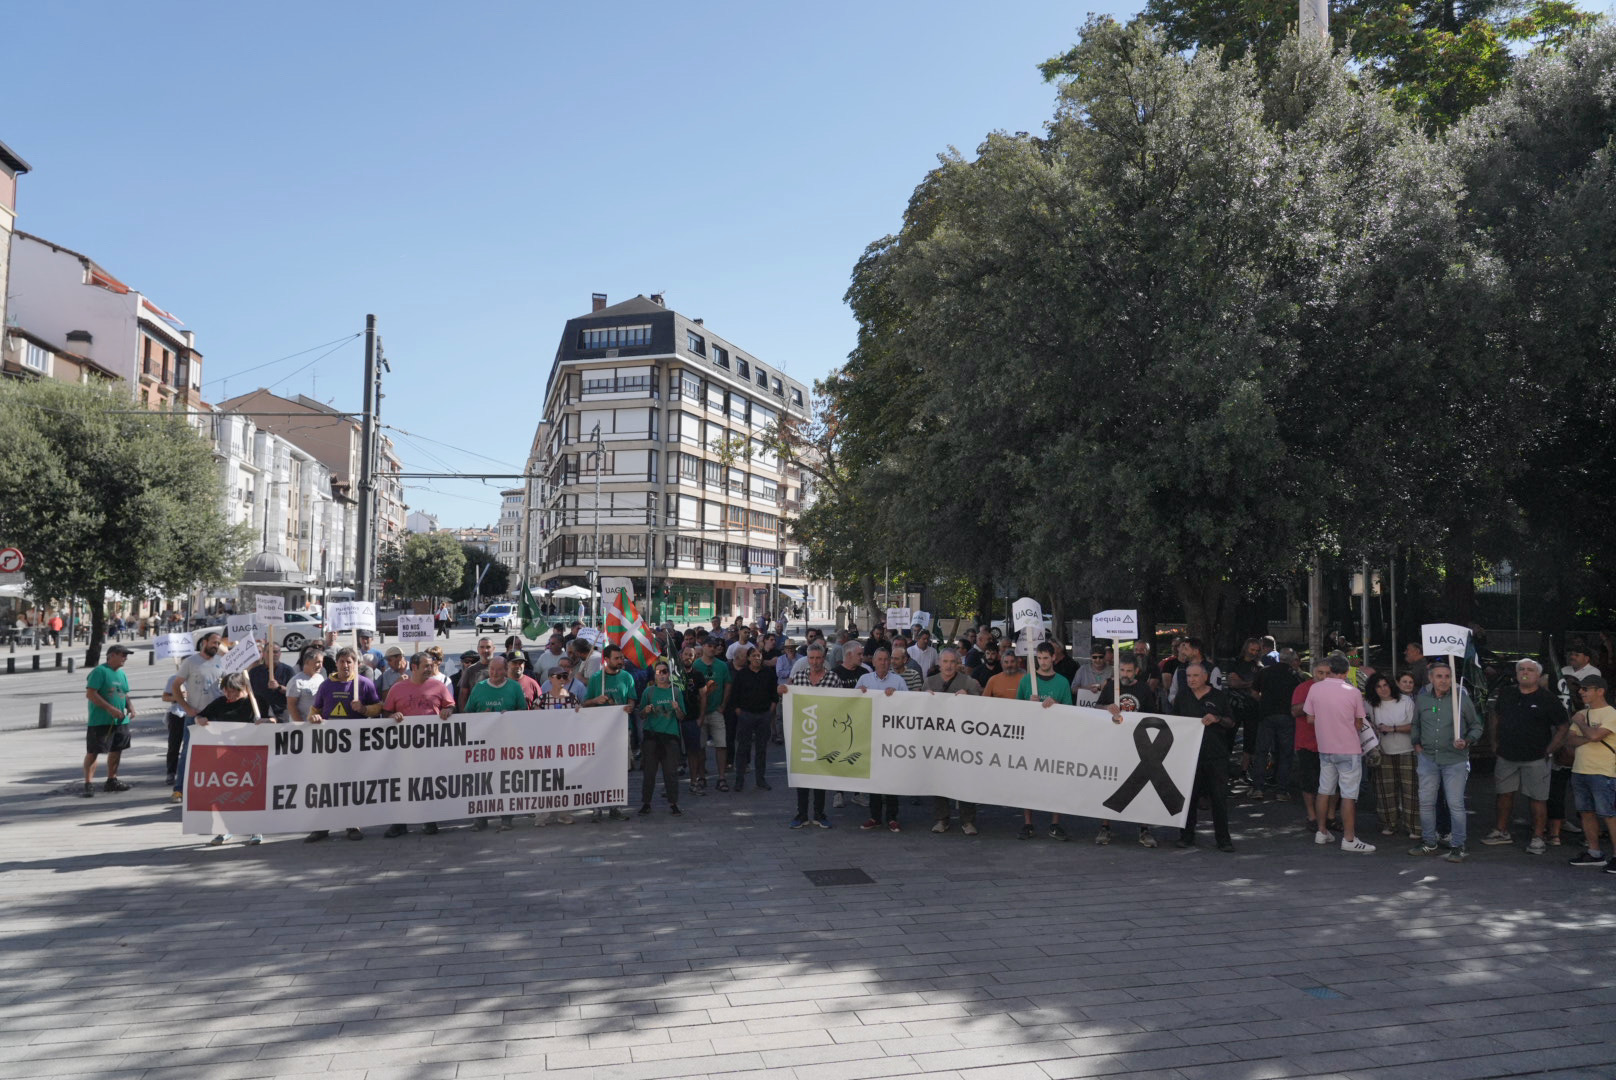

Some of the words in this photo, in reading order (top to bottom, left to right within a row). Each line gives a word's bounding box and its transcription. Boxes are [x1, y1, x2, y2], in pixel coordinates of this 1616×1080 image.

[1016, 608, 1038, 620] UAGA
[232, 624, 258, 632] UAGA
[1430, 635, 1464, 646] UAGA
[274, 730, 304, 756] NO
[312, 728, 352, 754] NOS
[360, 722, 486, 751] ESCUCHAN...
[801, 704, 818, 762] UAGA
[882, 714, 956, 732] PIKUTARA
[961, 720, 1025, 740] GOAZ!!!
[465, 750, 496, 764] PERO
[500, 747, 524, 761] NOS
[528, 746, 552, 759] VAN
[556, 744, 564, 758] A
[568, 742, 596, 757] OIR!!
[882, 744, 917, 760] NOS
[922, 746, 984, 766] VAMOS
[988, 752, 1002, 768] A
[1008, 754, 1028, 770] LA
[1034, 758, 1119, 782] MIERDA!!!
[194, 771, 254, 788] UAGA
[272, 784, 298, 810] EZ
[305, 778, 400, 808] GAITUZTE
[408, 772, 494, 802] KASURIK
[500, 768, 582, 794] EGITEN...
[468, 798, 504, 814] BAINA
[509, 793, 569, 812] ENTZUNGO
[574, 788, 624, 806] DIGUTE!!!
